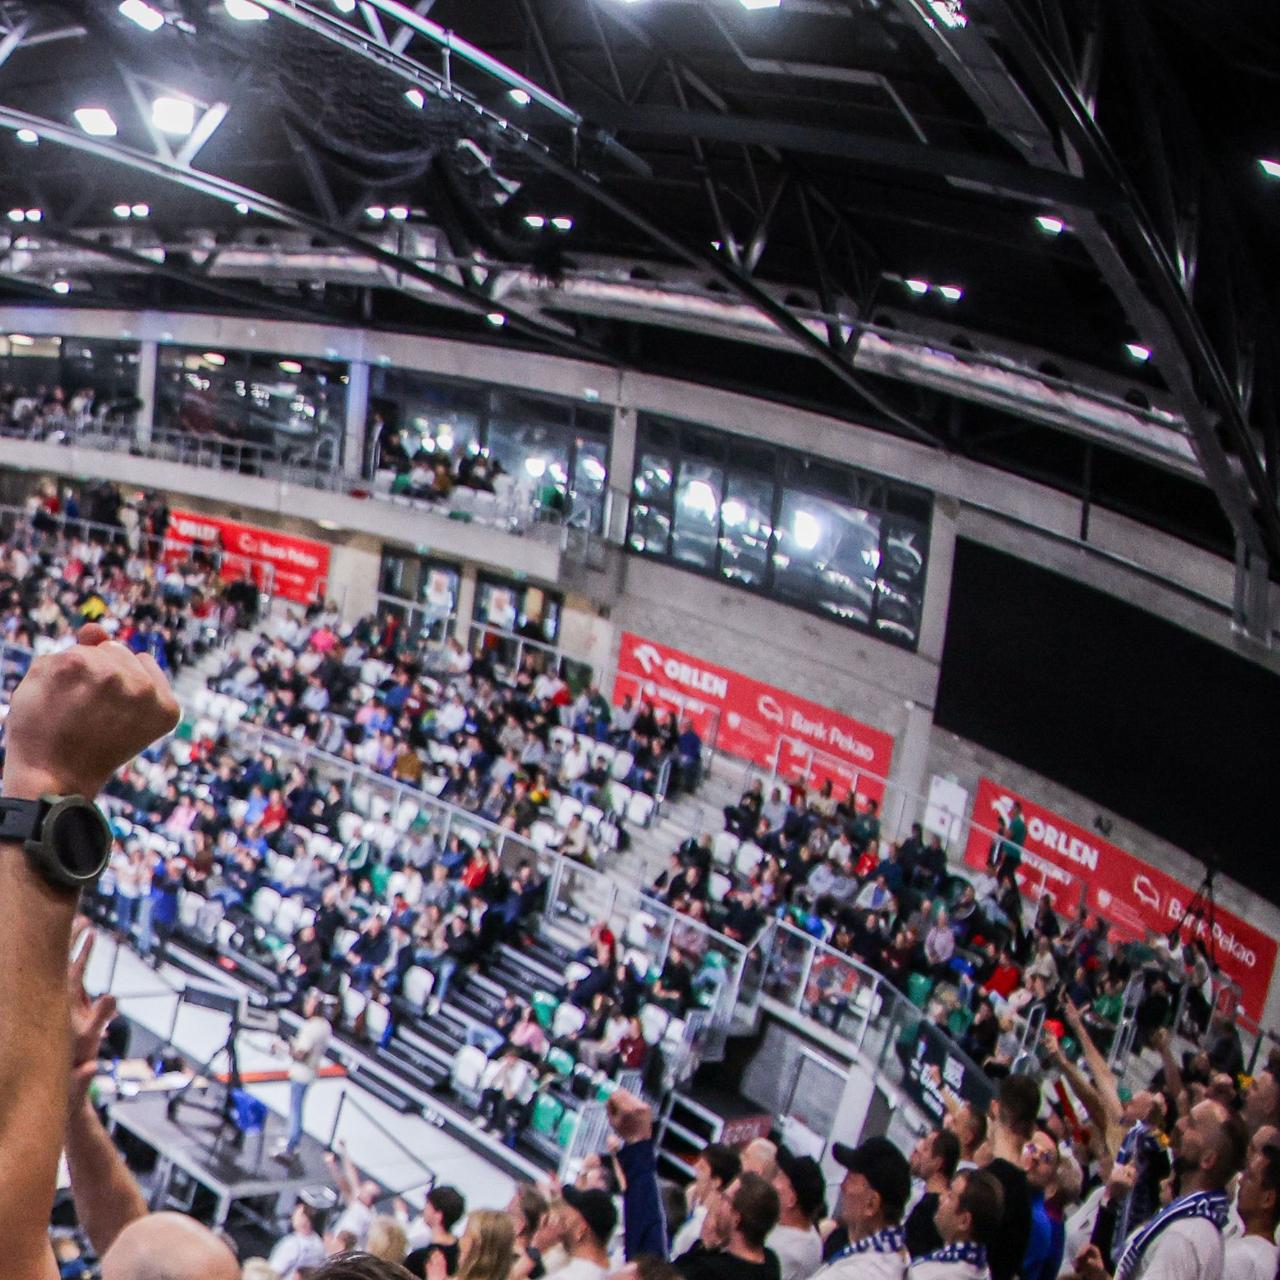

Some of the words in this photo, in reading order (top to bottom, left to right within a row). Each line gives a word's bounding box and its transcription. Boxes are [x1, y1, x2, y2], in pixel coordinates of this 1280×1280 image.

[664, 659, 728, 698] ORLEN
[791, 710, 826, 740] Bank
[829, 726, 874, 762] Pekao
[1028, 817, 1099, 871] ORLEN
